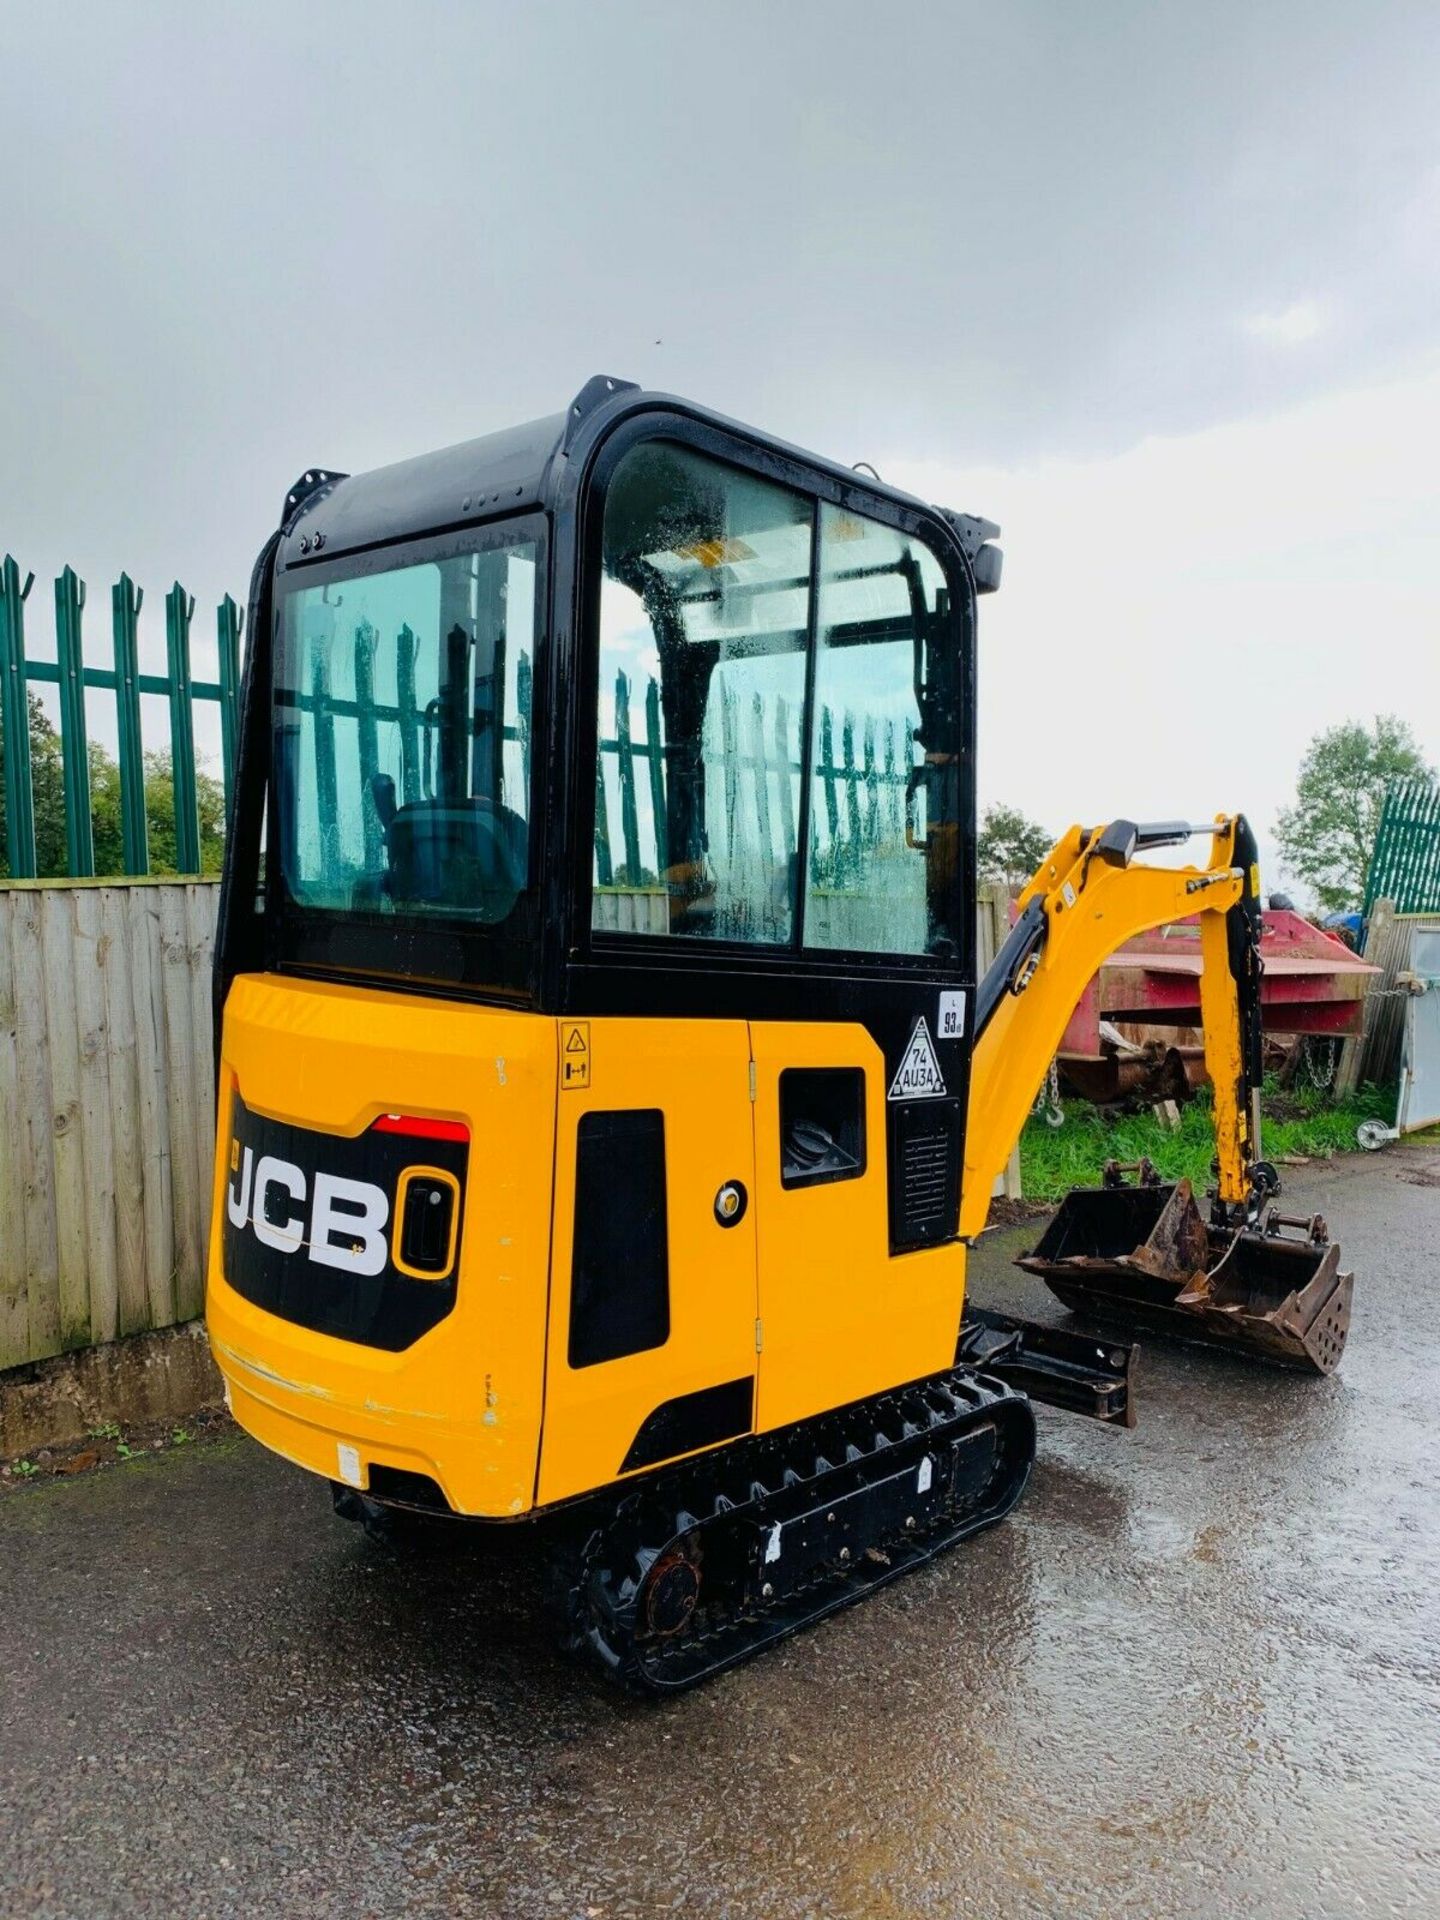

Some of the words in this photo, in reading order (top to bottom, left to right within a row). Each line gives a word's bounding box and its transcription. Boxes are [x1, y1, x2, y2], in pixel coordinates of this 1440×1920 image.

[944, 1012, 957, 1034] 93
[912, 1048, 927, 1067] 74
[903, 1068, 933, 1088] AU3A
[228, 1146, 389, 1276] JCB
